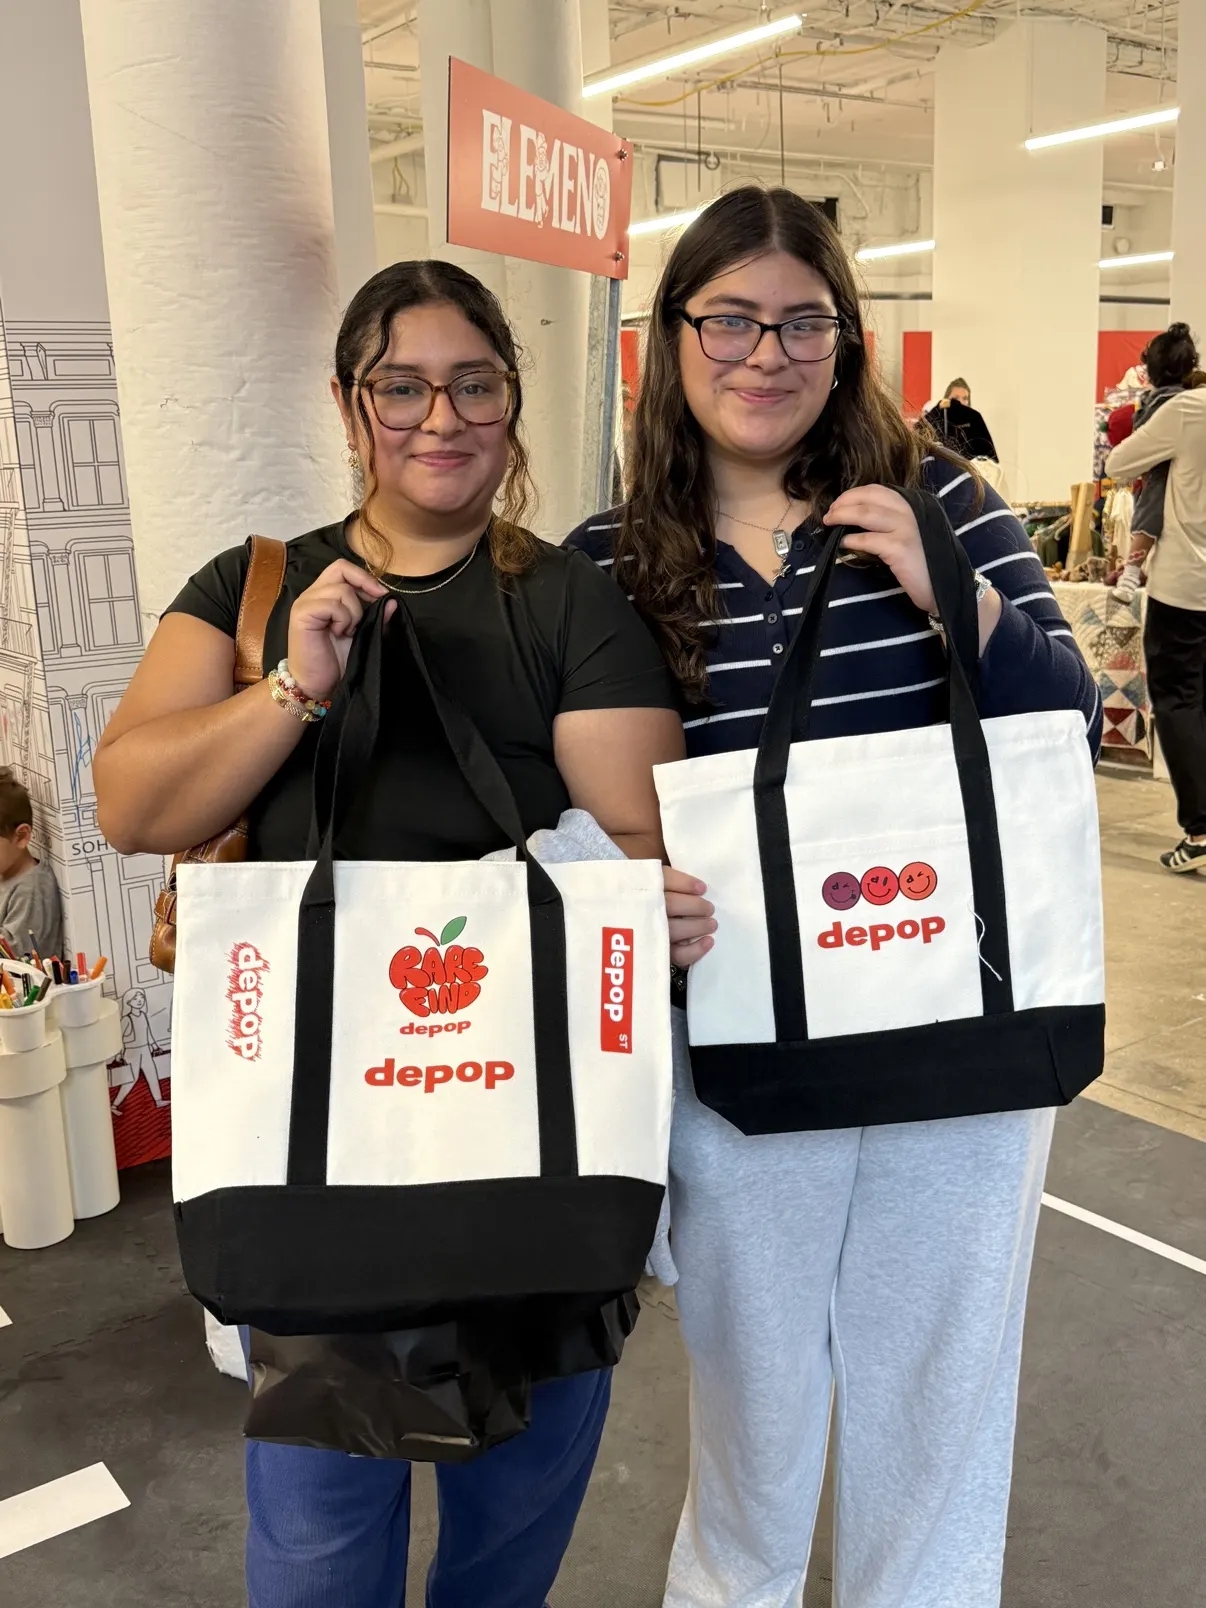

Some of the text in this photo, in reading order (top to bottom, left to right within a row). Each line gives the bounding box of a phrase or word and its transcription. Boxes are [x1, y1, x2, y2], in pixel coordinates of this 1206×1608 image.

[481, 108, 611, 240] ELEMENO
[817, 916, 946, 951] depop
[389, 944, 489, 989] RARE
[231, 947, 264, 1058] depop
[398, 982, 482, 1018] FIND
[604, 933, 631, 1050] depop ST
[399, 1020, 472, 1039] depop
[364, 1057, 515, 1093] depop
